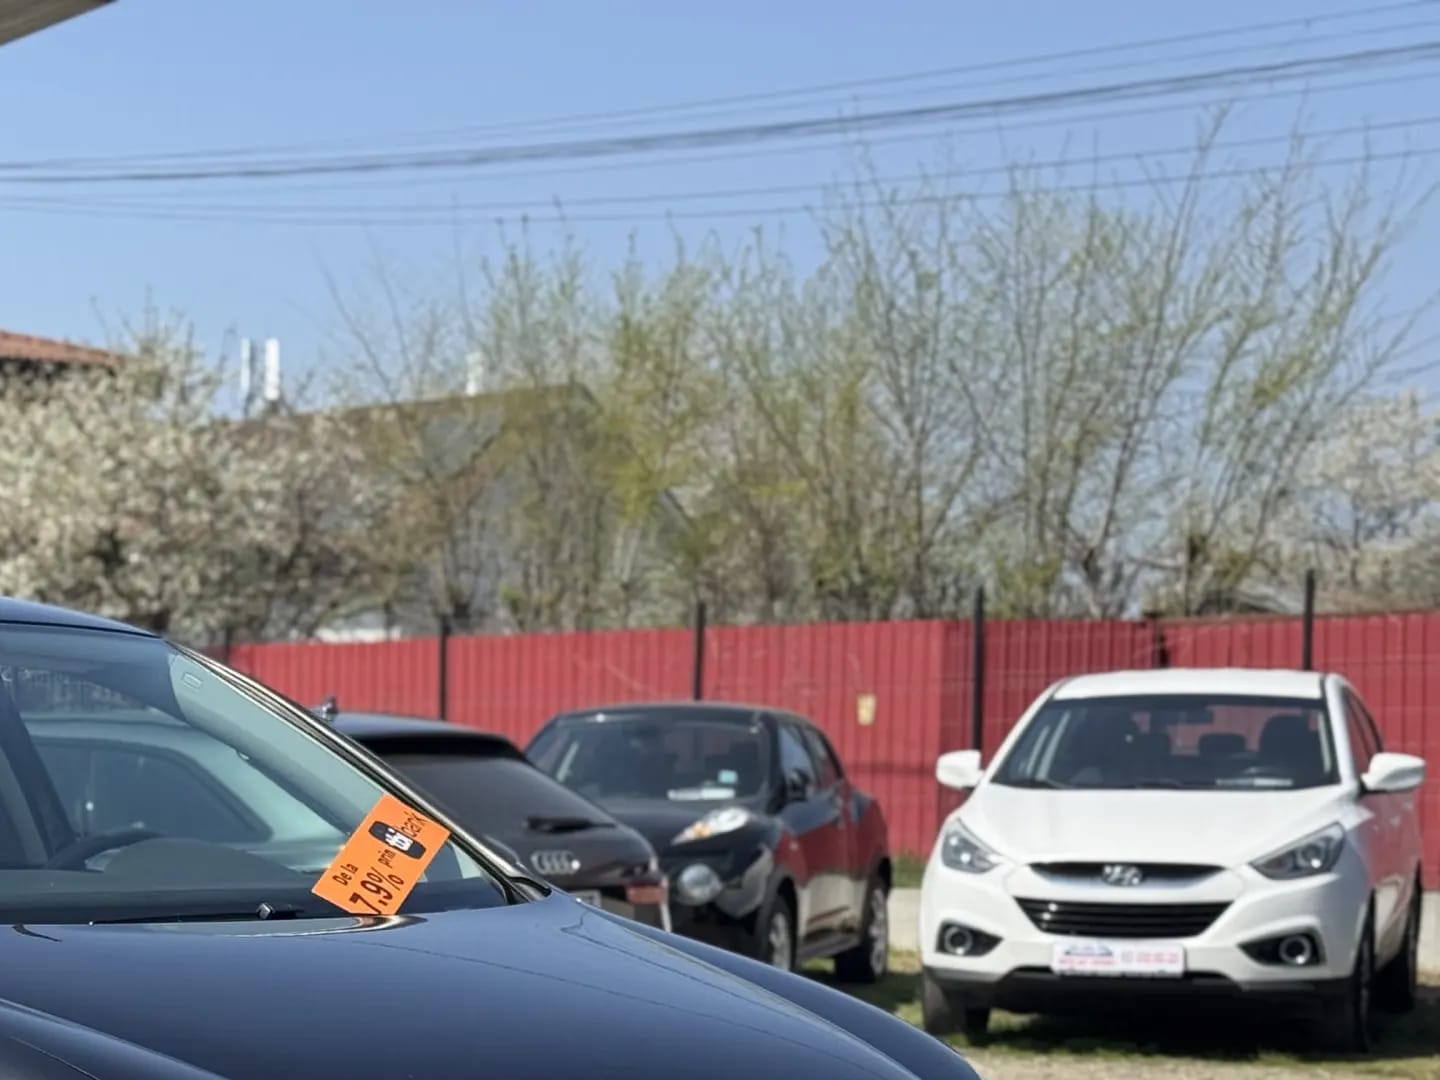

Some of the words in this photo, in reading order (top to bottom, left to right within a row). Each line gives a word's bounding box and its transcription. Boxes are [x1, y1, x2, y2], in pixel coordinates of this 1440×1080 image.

[340, 863, 359, 875] la
[332, 872, 353, 886] De
[349, 866, 405, 915] 7.9%
